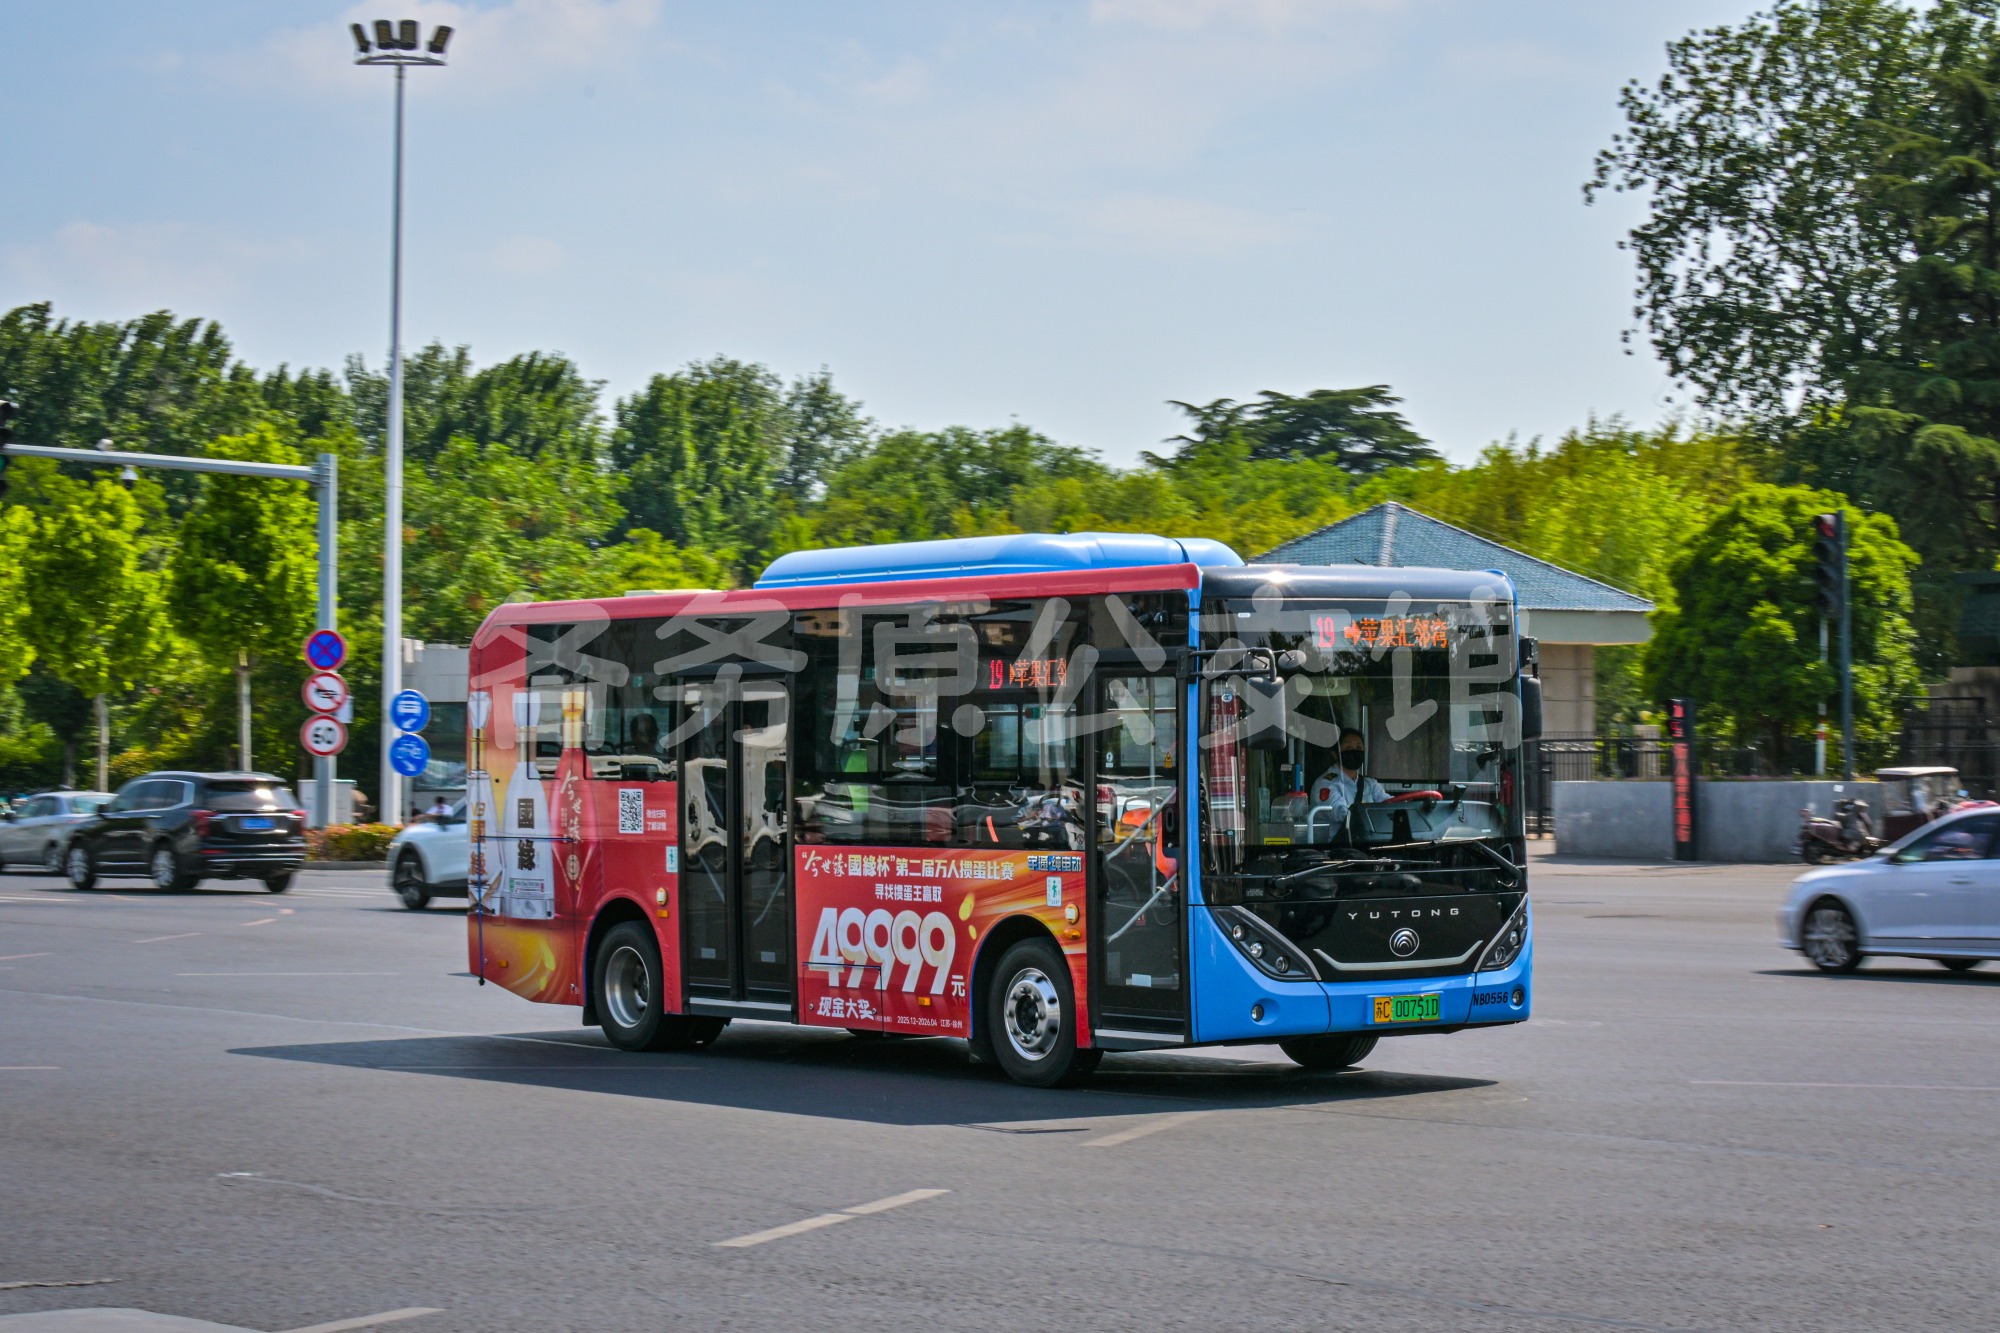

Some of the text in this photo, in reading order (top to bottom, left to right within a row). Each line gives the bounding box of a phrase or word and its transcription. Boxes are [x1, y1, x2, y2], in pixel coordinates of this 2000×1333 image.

[1316, 616, 1336, 648] 19
[989, 659, 1004, 690] 19
[1348, 907, 1461, 920] YUTONG
[816, 996, 875, 1021] 现金大奖
[1473, 991, 1509, 1006] NB0556
[897, 1015, 938, 1028] 2025.12-2026.04
